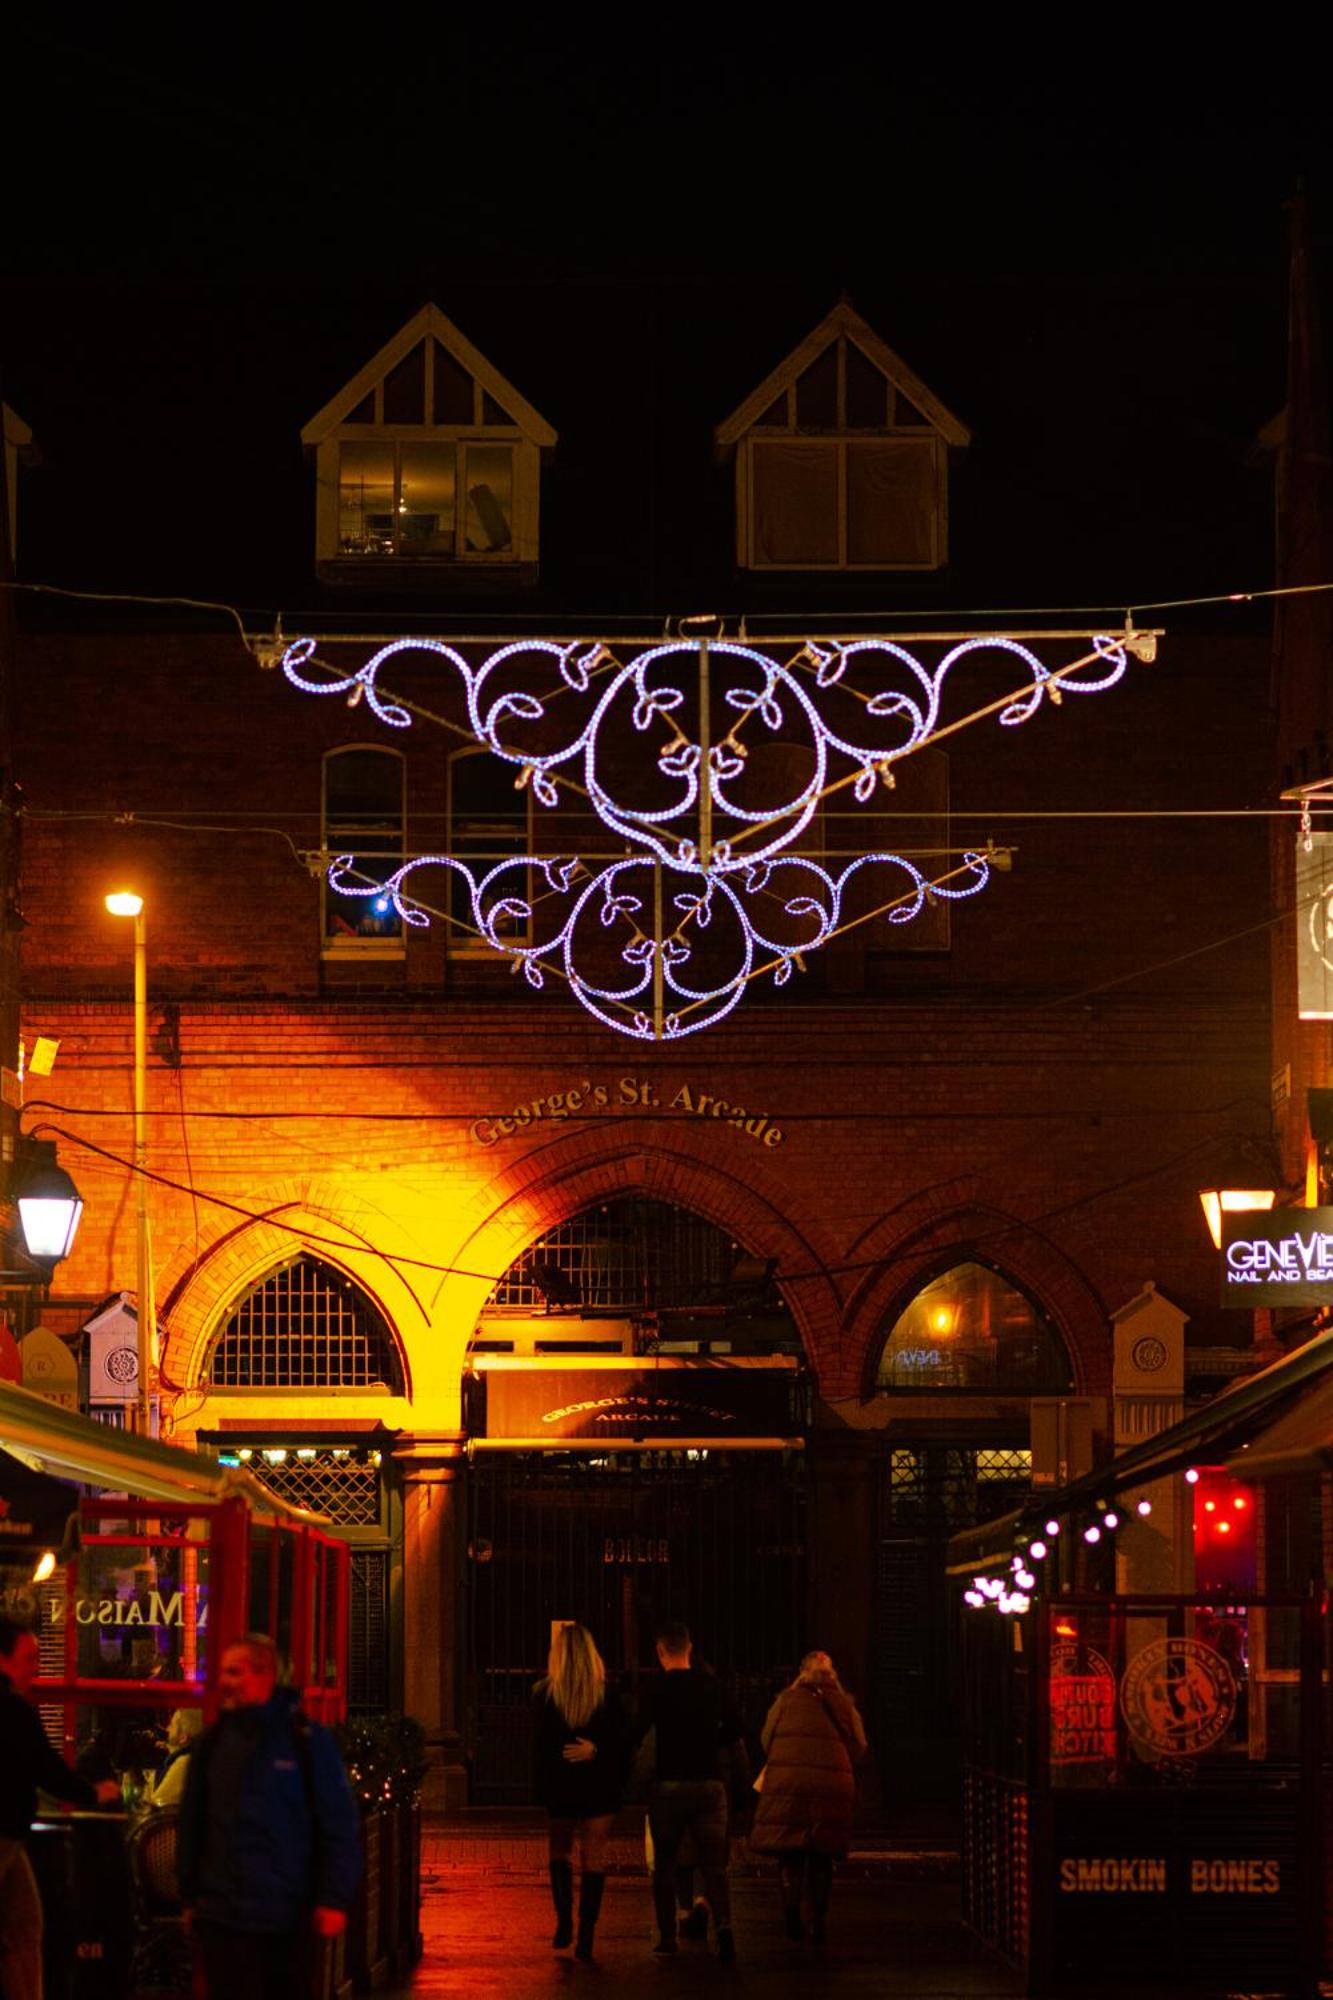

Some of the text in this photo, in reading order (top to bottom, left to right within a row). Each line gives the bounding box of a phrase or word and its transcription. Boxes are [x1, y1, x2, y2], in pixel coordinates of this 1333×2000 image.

[470, 1076, 784, 1148] George's St. Arcade
[1227, 1270, 1263, 1283] NAIL
[1266, 1270, 1301, 1283] AND
[541, 1396, 649, 1423] GEORGE'S
[1059, 1857, 1281, 1894] SMOKIN BONES
